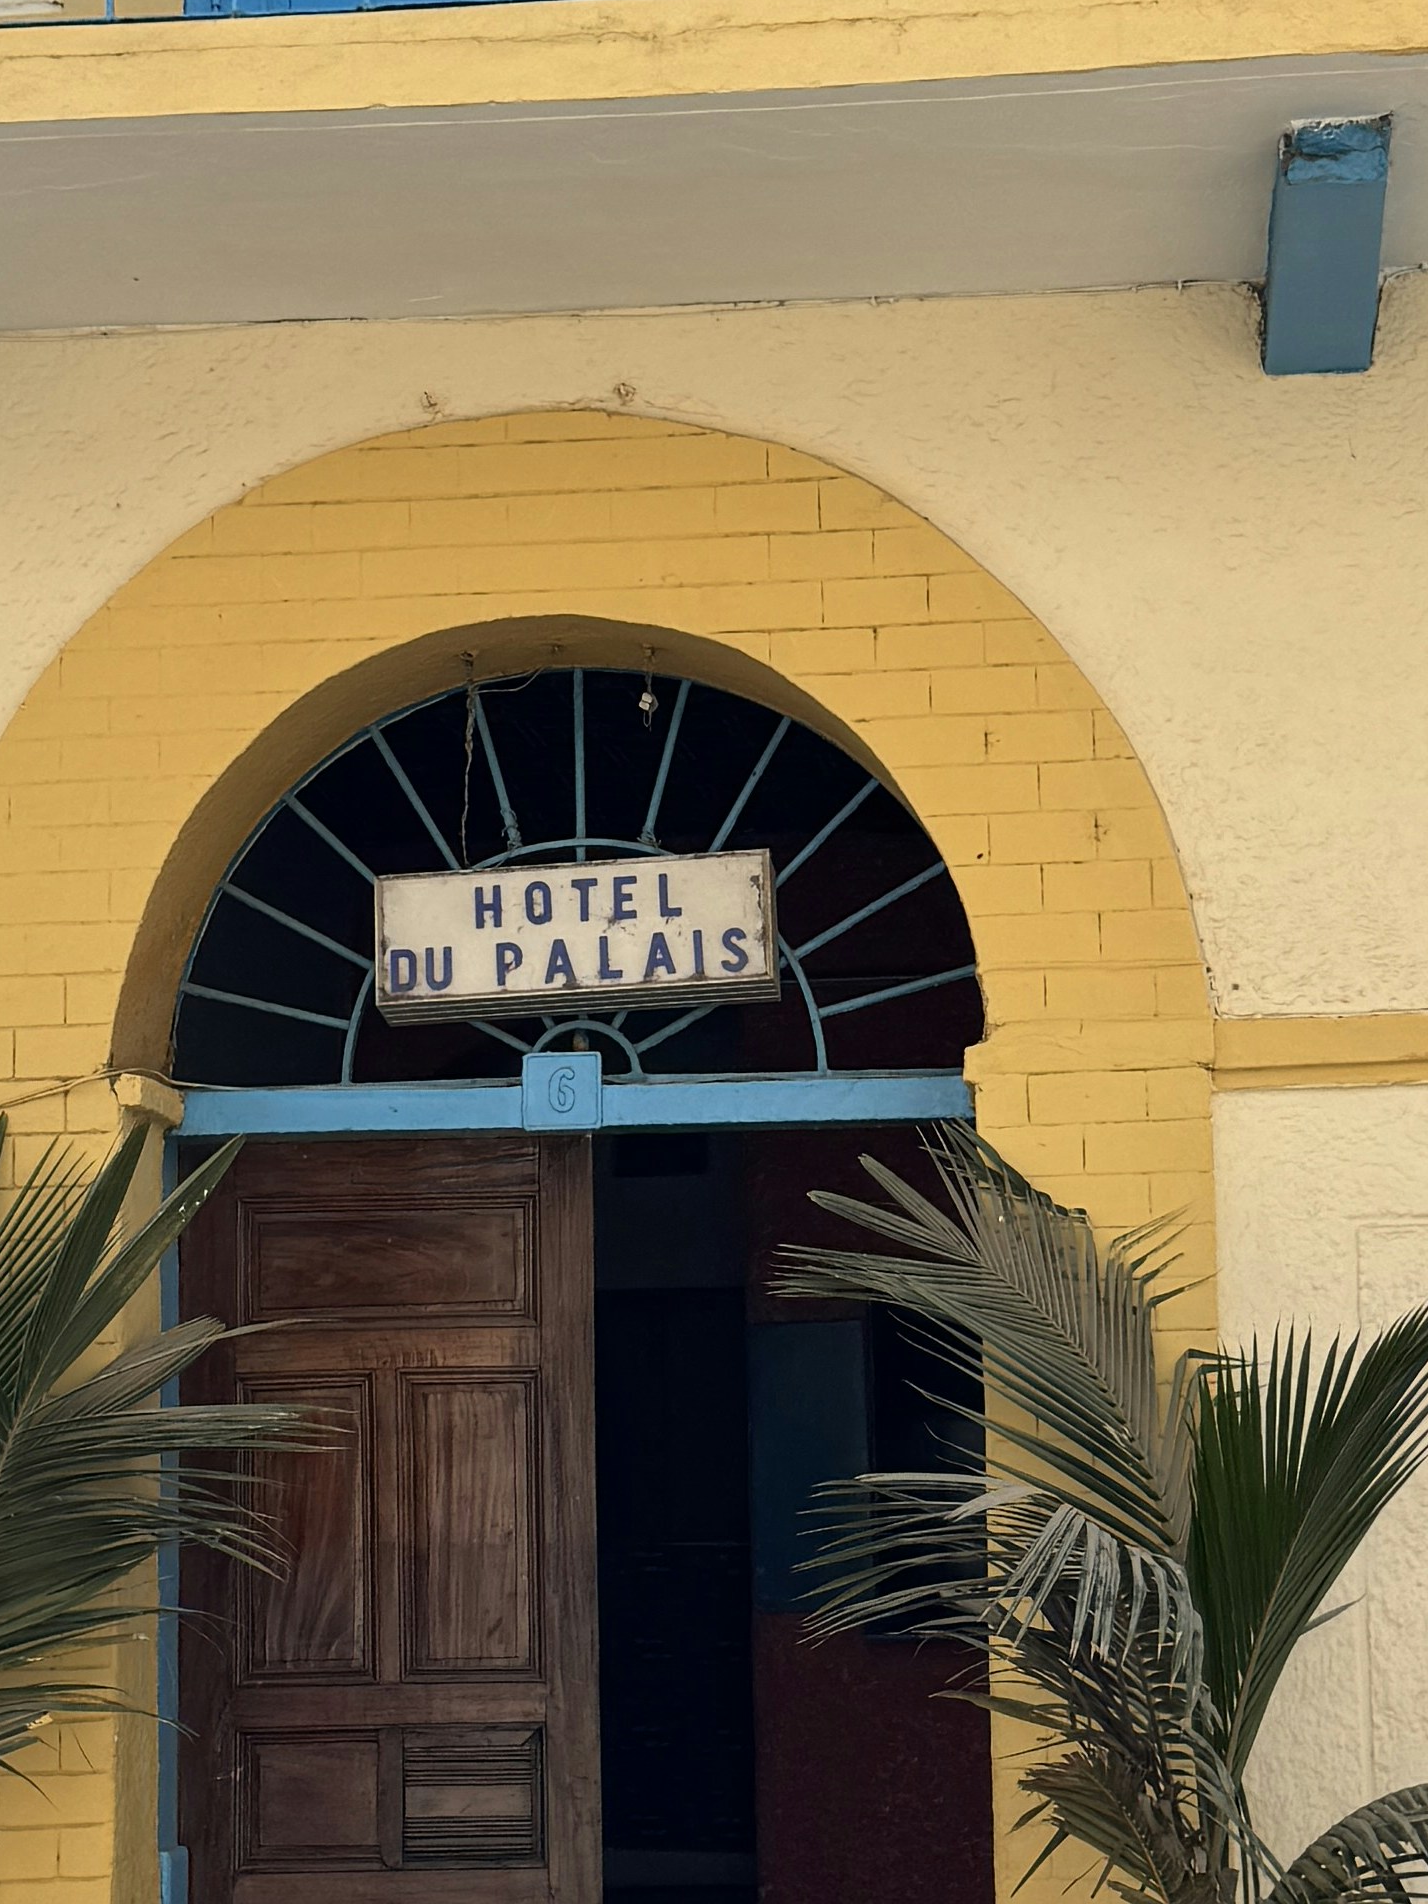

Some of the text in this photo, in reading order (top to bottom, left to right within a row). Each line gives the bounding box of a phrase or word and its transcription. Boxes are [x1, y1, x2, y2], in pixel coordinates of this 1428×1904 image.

[474, 872, 683, 930] HOTEL
[389, 927, 749, 993] DU PALAIS
[548, 1066, 575, 1113] 6
